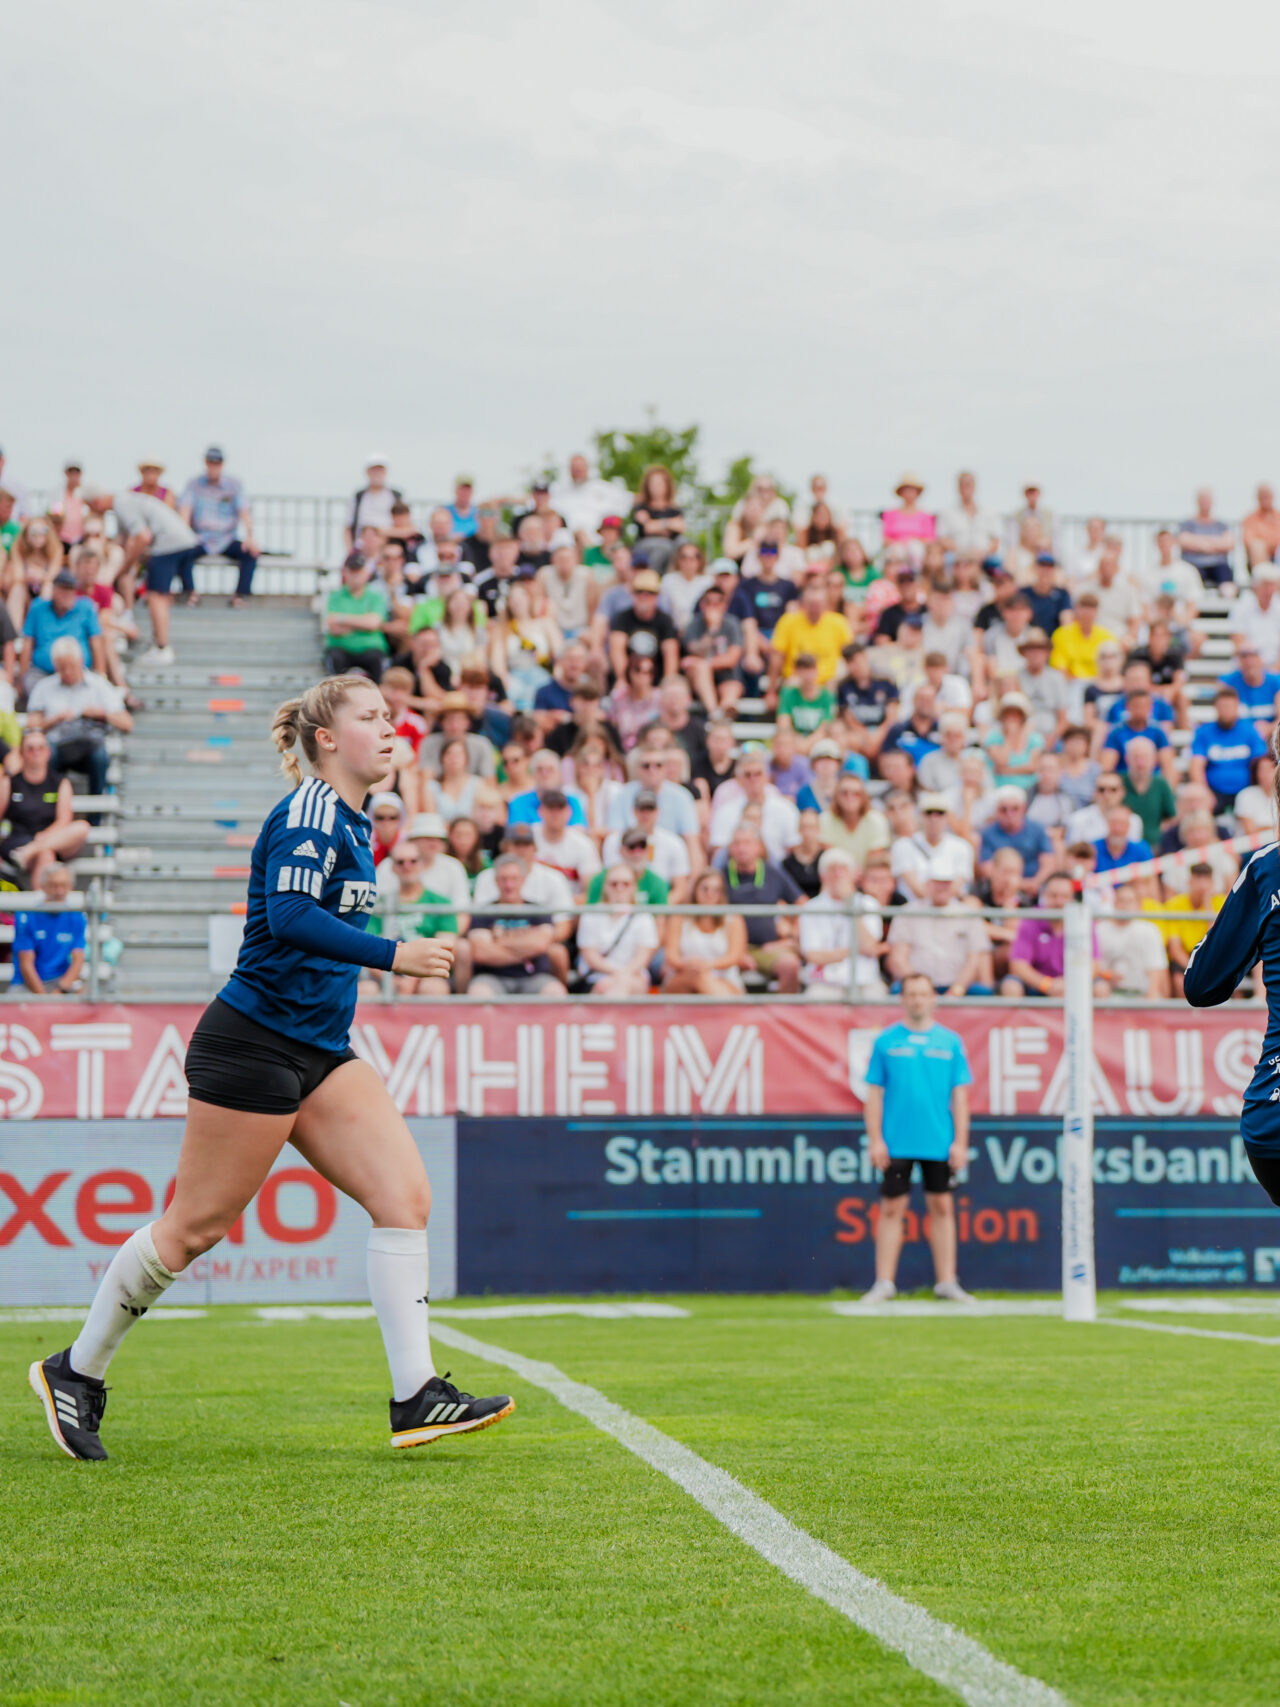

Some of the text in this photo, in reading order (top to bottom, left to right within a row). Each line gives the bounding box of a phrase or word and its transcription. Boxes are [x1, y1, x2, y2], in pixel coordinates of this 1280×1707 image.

[0, 1023, 764, 1118] STAMHEIM
[0, 1167, 337, 1247] xeo
[836, 1197, 1038, 1243] Staion
